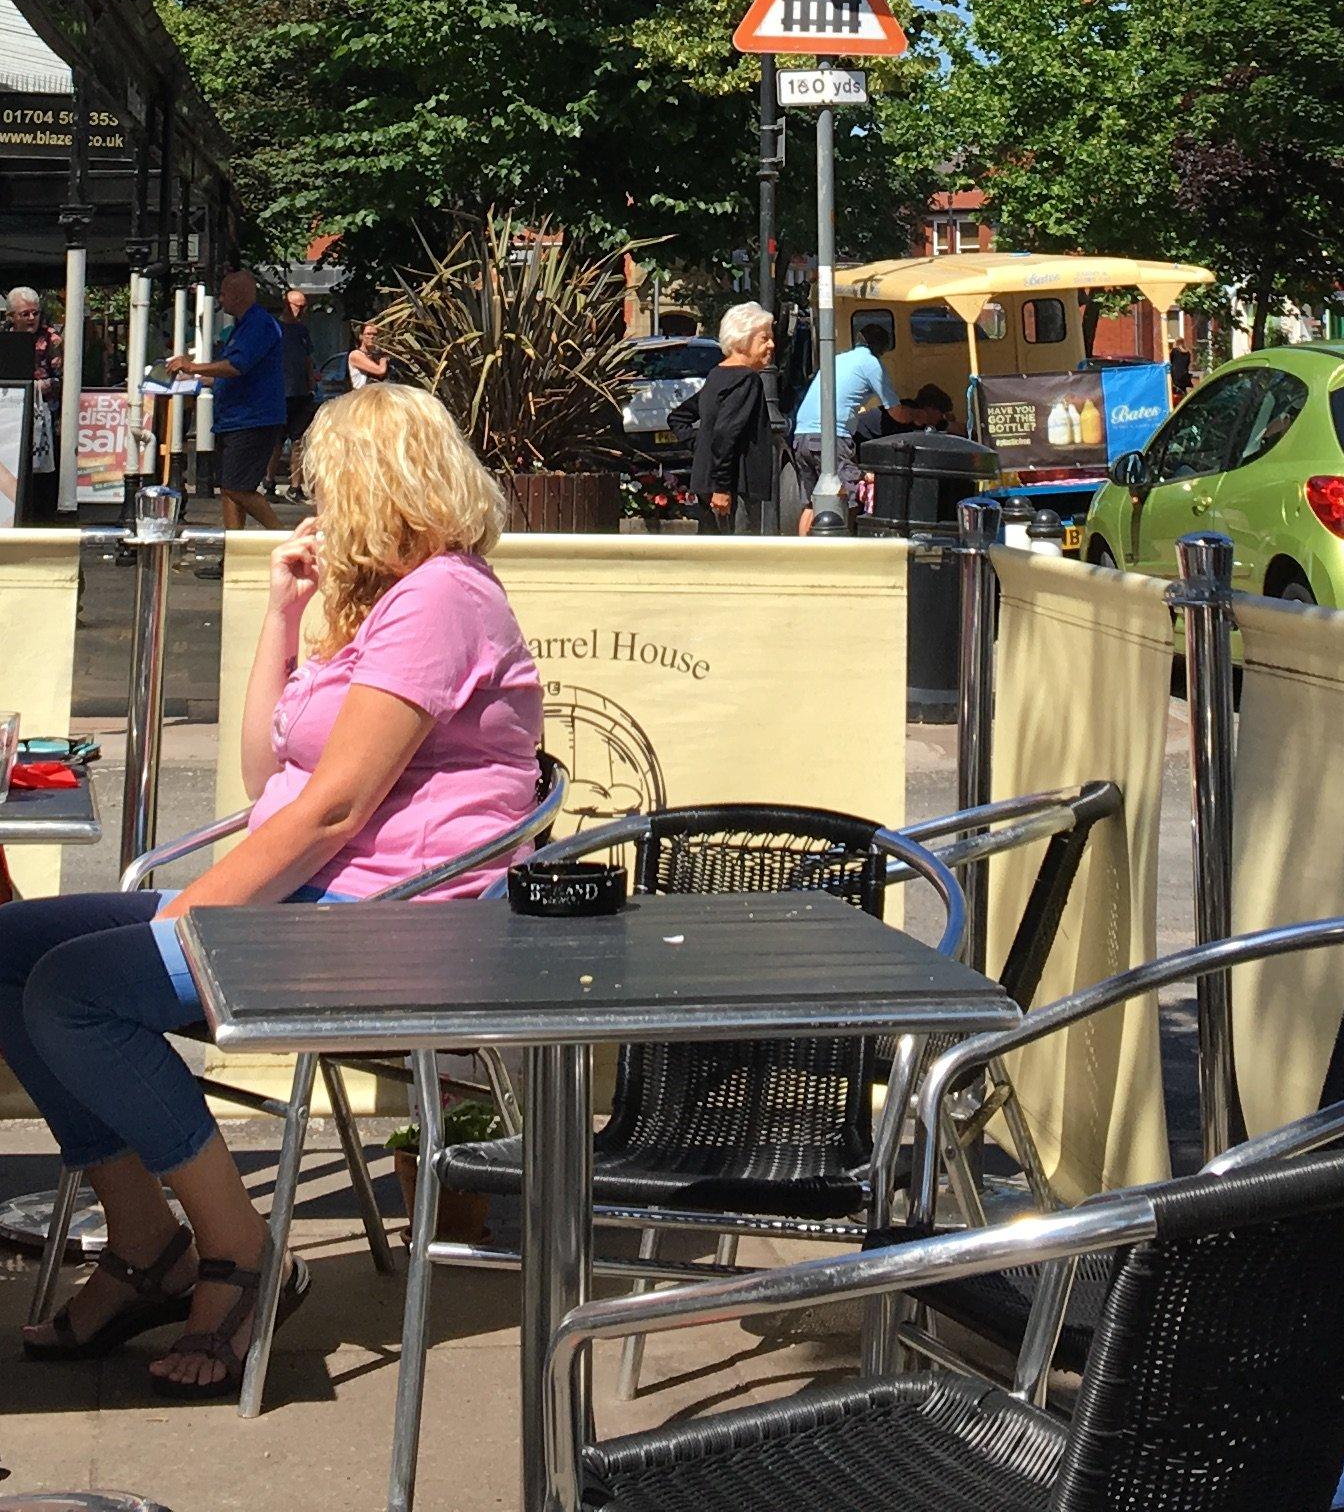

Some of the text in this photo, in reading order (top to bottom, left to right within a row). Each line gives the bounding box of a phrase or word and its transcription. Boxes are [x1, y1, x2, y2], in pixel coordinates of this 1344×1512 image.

[833, 78, 861, 96] yds
[3, 110, 54, 124] 01704
[97, 395, 122, 411] Ex
[988, 407, 1013, 415] HAVE
[1111, 405, 1162, 424] Bates
[988, 414, 1036, 424] GOT THE
[989, 423, 1036, 433] BOTTLE?
[528, 629, 711, 680] arrel House
